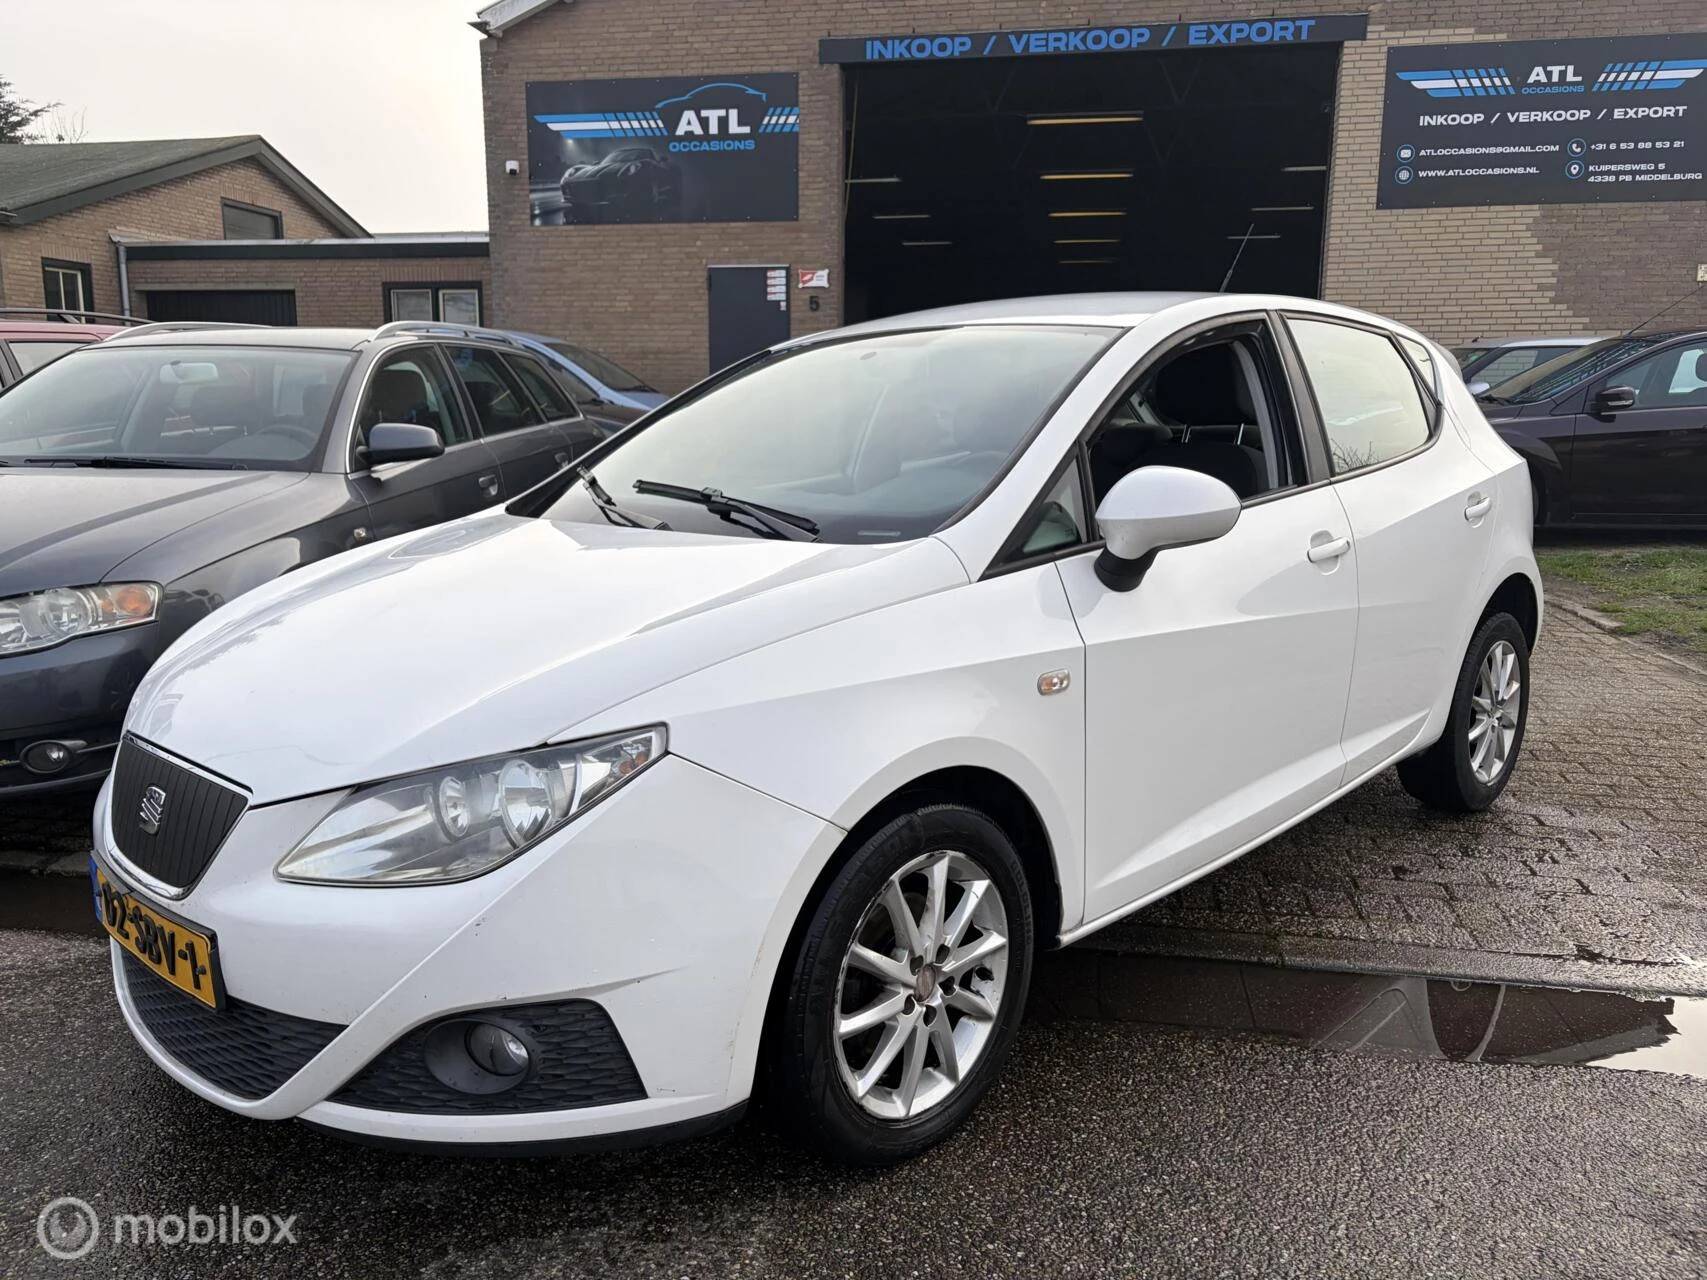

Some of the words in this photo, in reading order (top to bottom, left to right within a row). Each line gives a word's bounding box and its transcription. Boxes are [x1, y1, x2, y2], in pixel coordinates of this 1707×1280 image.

[866, 36, 972, 60] INKOOP
[982, 35, 997, 55] /
[1008, 27, 1150, 53] VERKOOP
[1161, 26, 1176, 47] /
[1188, 19, 1316, 45] EXPORT
[1527, 65, 1583, 83] ATL
[1521, 85, 1585, 95] OCCASIONS
[675, 108, 751, 135] ATL
[1419, 113, 1485, 127] INKOOP
[1490, 112, 1501, 124] /
[1507, 109, 1591, 124] VERKOOP
[1597, 108, 1607, 120] /
[1613, 105, 1688, 120] EXPORT
[669, 139, 756, 152] OCCASIONS
[1609, 142, 1617, 150] 6
[1655, 141, 1670, 149] 53
[1673, 140, 1684, 148] 21
[1418, 167, 1539, 178] WWW.ATLOCCASIONS.NL
[1588, 163, 1655, 172] KUIPERSWEG
[1588, 175, 1616, 183] 4338
[1635, 173, 1703, 181] MIDDELBURG
[809, 295, 820, 312] 5
